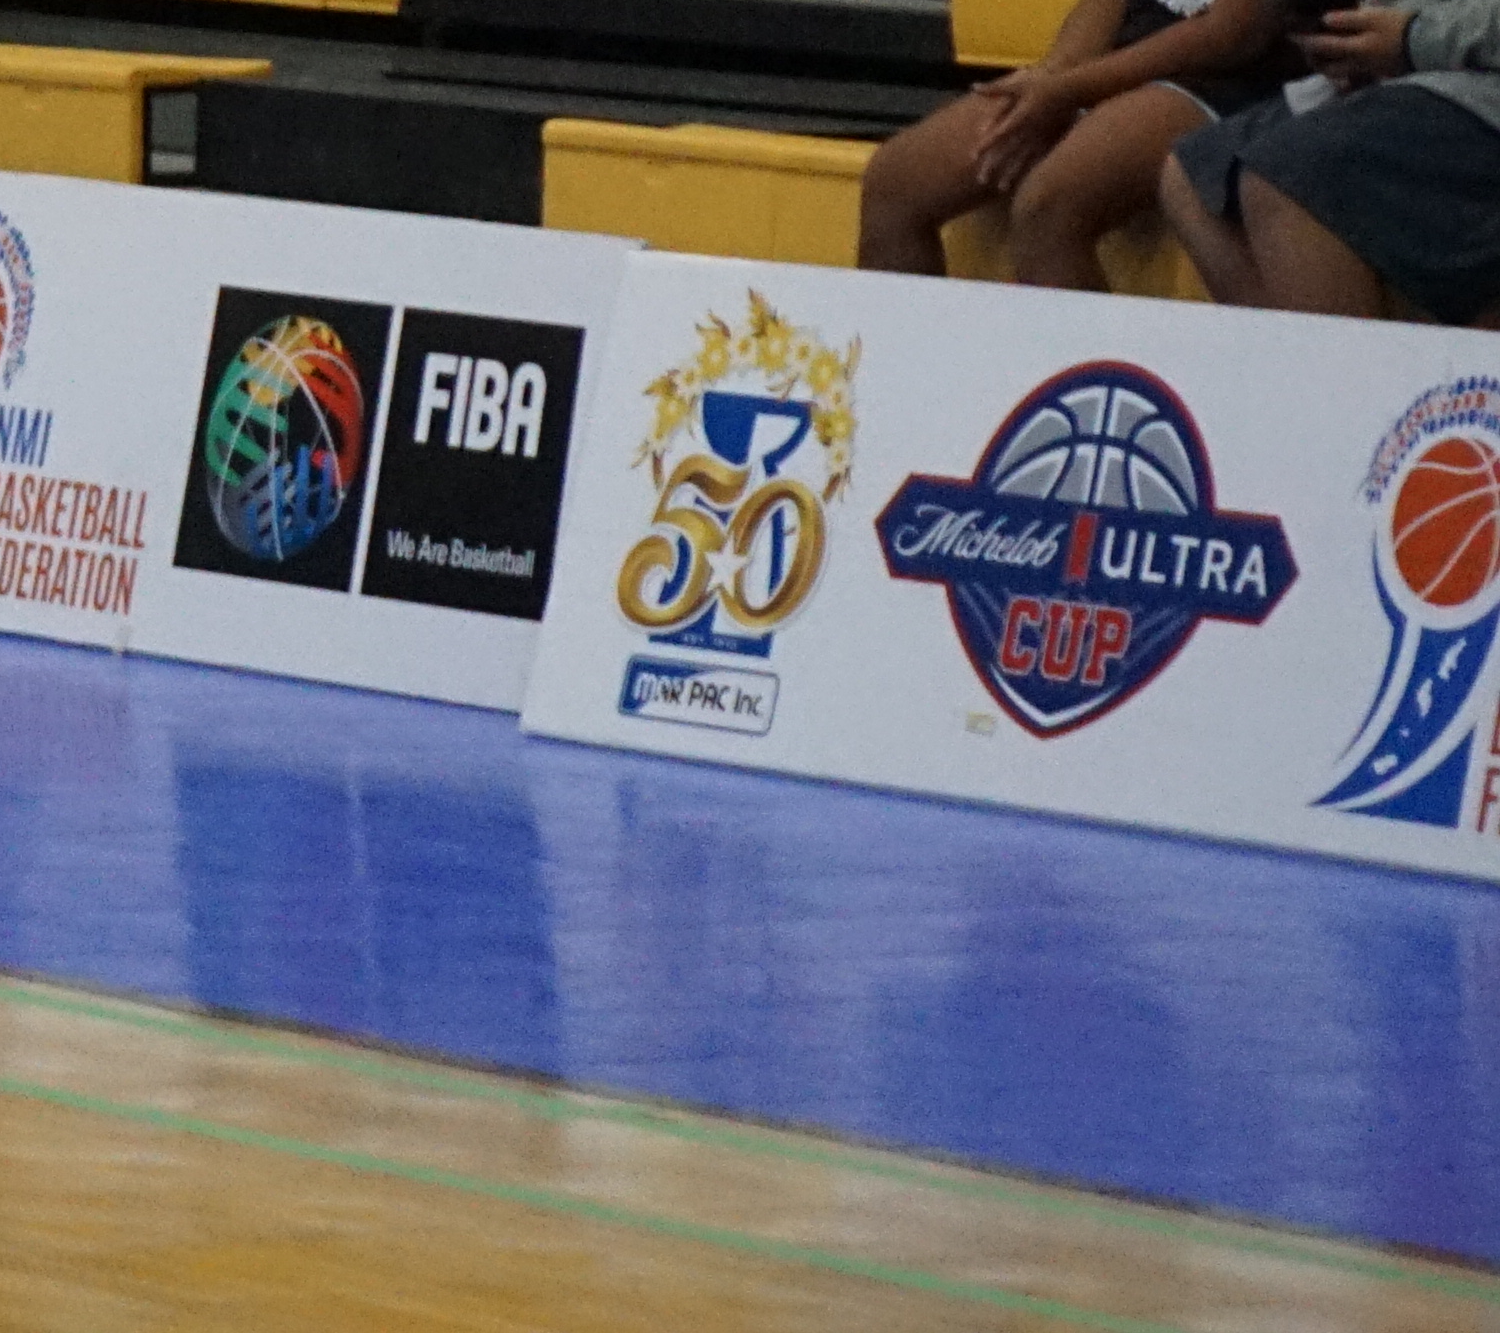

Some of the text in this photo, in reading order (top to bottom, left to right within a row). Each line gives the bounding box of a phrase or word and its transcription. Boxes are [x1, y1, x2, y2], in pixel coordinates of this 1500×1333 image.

[414, 352, 547, 458] FIBA
[386, 529, 536, 579] We Are Basketball
[616, 453, 827, 631] 50
[896, 503, 1269, 598] Michelob ULTRA
[999, 594, 1133, 687] CUP
[687, 680, 731, 712] PAC
